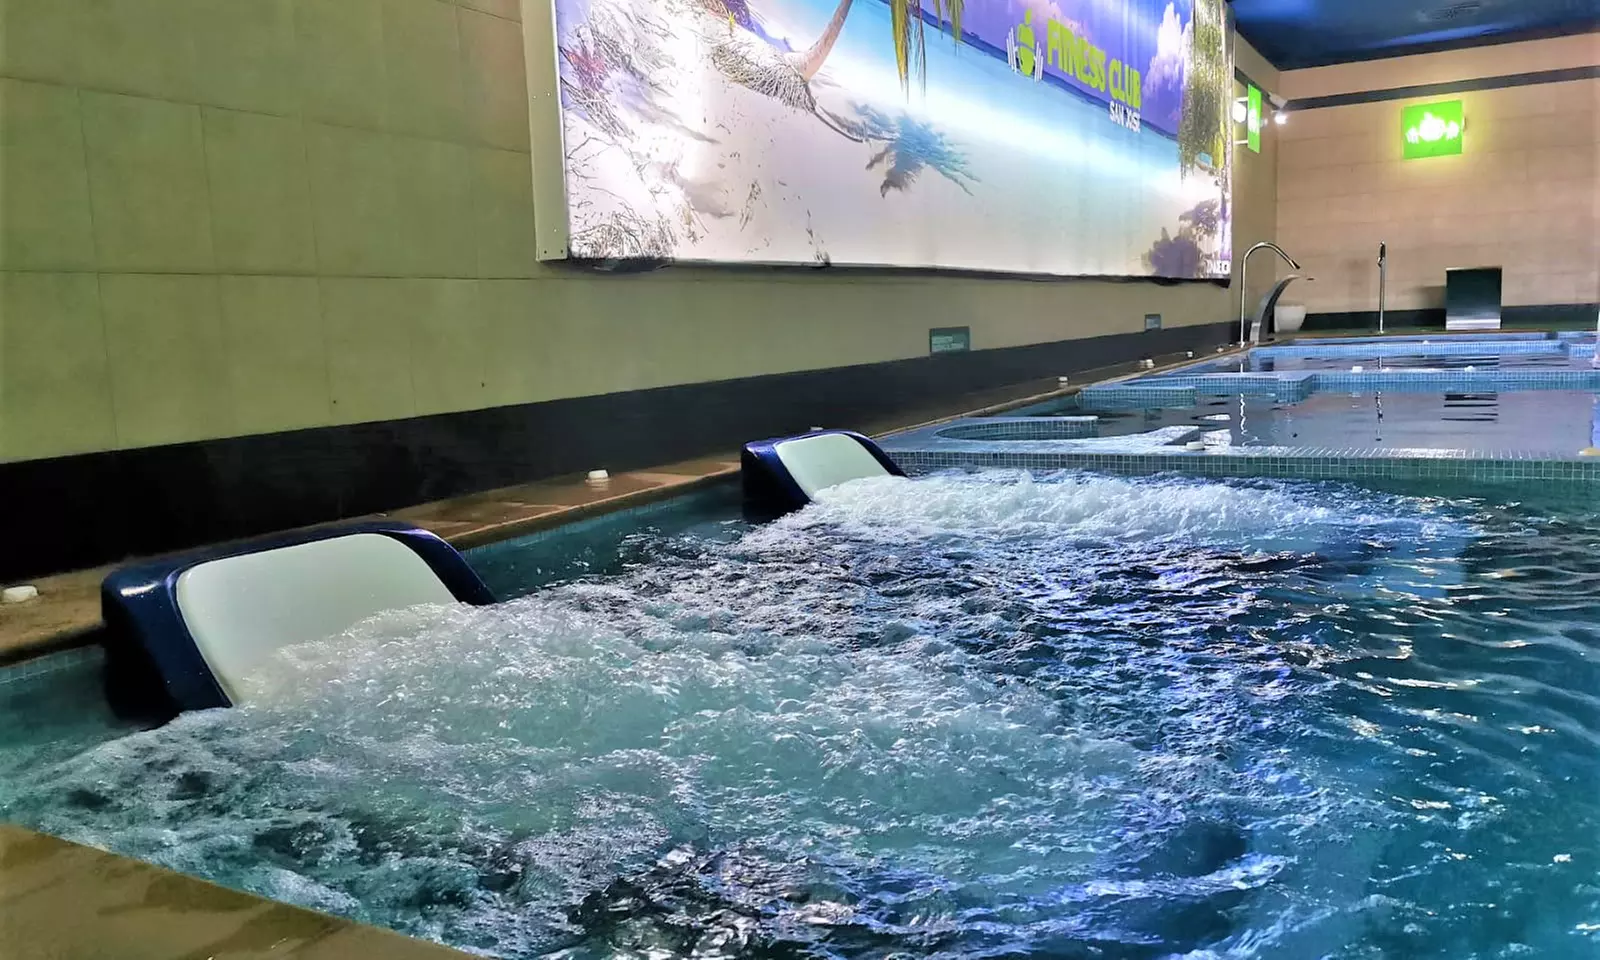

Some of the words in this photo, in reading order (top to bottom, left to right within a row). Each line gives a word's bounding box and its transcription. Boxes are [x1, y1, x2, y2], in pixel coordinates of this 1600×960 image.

[1047, 18, 1106, 92] FITNESS
[1108, 58, 1142, 108] CLUB
[1109, 100, 1125, 127] SAN
